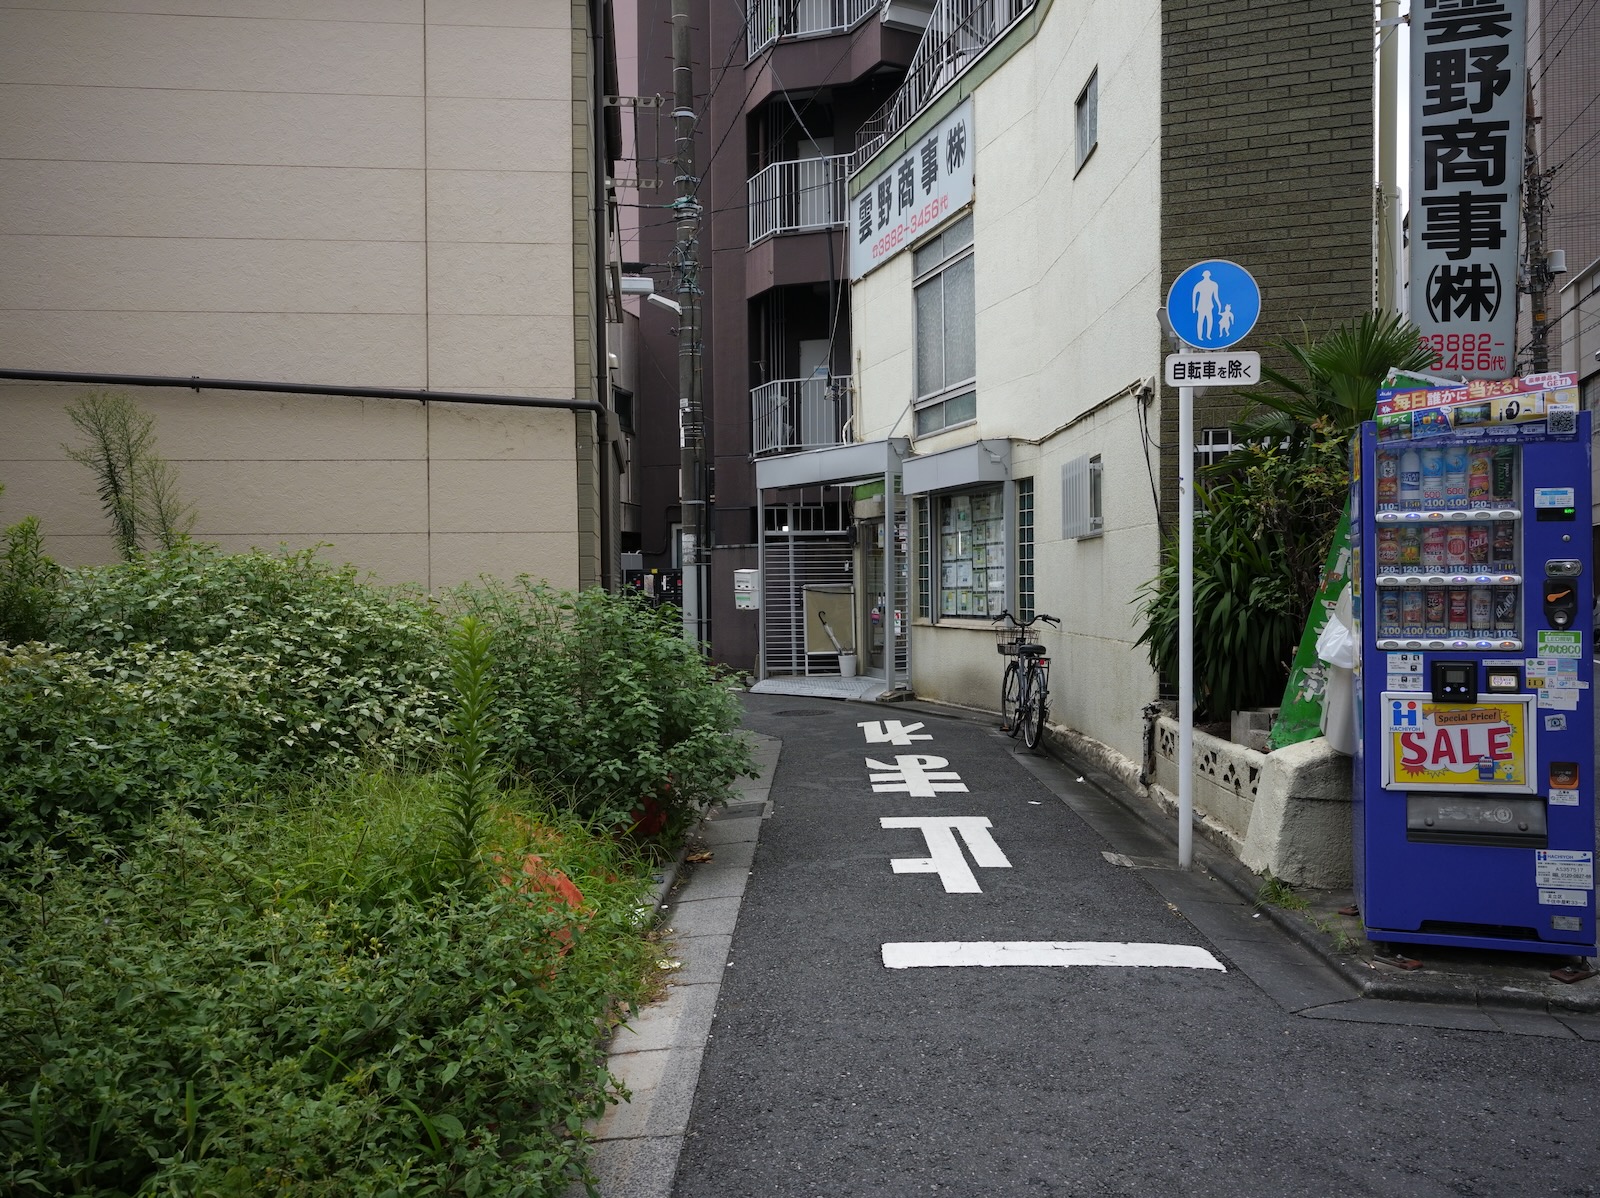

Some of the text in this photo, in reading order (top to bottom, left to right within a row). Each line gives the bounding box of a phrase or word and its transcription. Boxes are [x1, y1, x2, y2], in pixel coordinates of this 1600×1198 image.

[1173, 360, 1251, 379] 自転車を除く
[1438, 711, 1497, 723] Special Price!
[1400, 726, 1513, 765] SALE
[857, 720, 1013, 893] 止まれ
